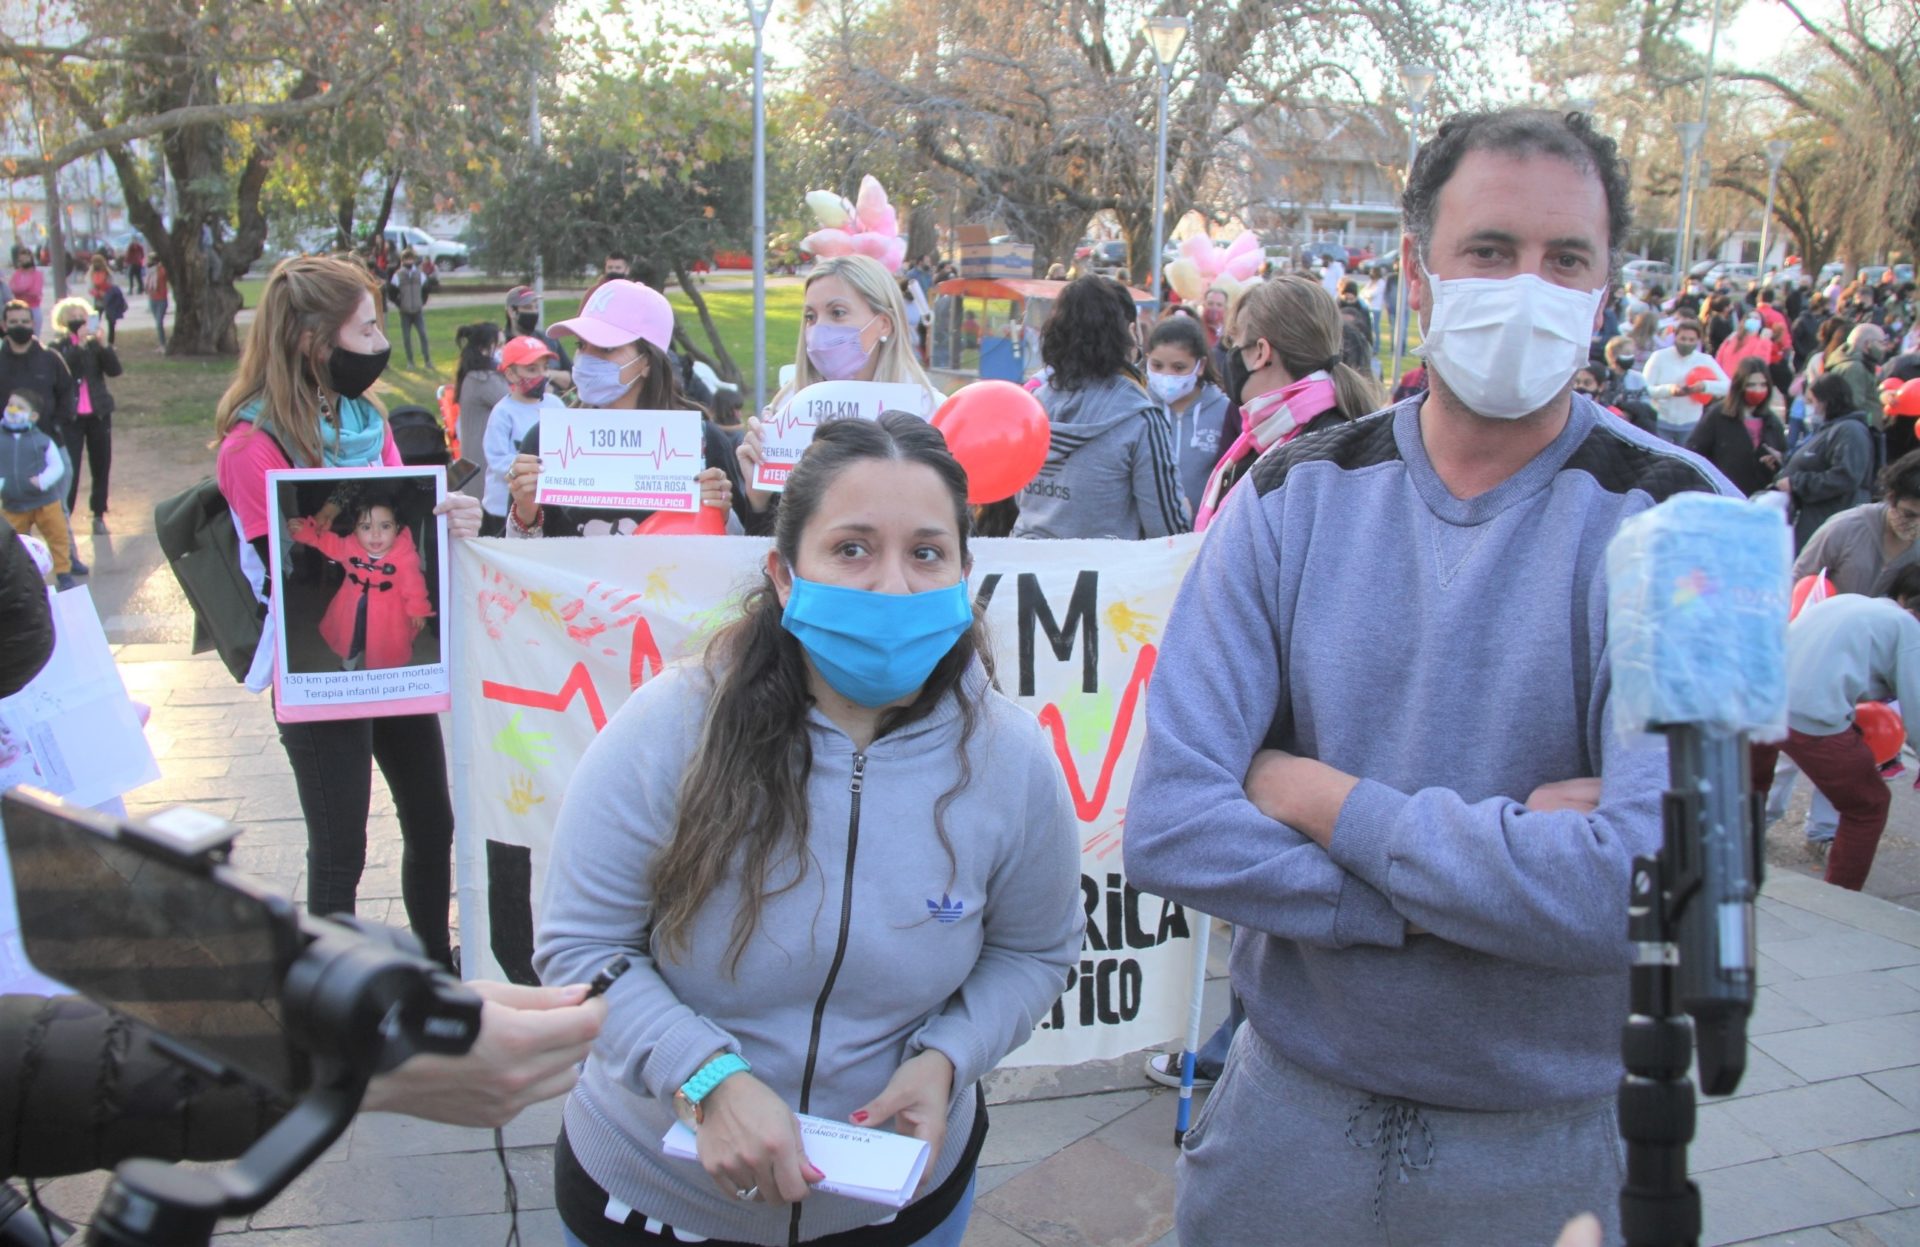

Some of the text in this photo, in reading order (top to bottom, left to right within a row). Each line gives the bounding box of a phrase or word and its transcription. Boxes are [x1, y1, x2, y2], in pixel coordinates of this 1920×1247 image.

[808, 399, 860, 419] 130 KM
[589, 428, 642, 448] 130 KM
[544, 475, 595, 487] GENERAL PICO
[634, 480, 687, 492] SANTA ROSA
[545, 494, 685, 507] #TERAPIAINFANTILGENERALPICO
[283, 665, 445, 687] 130 km para mi fueron mortales
[303, 688, 344, 700] Terapia
[346, 686, 380, 697] infantil
[382, 685, 406, 696] para
